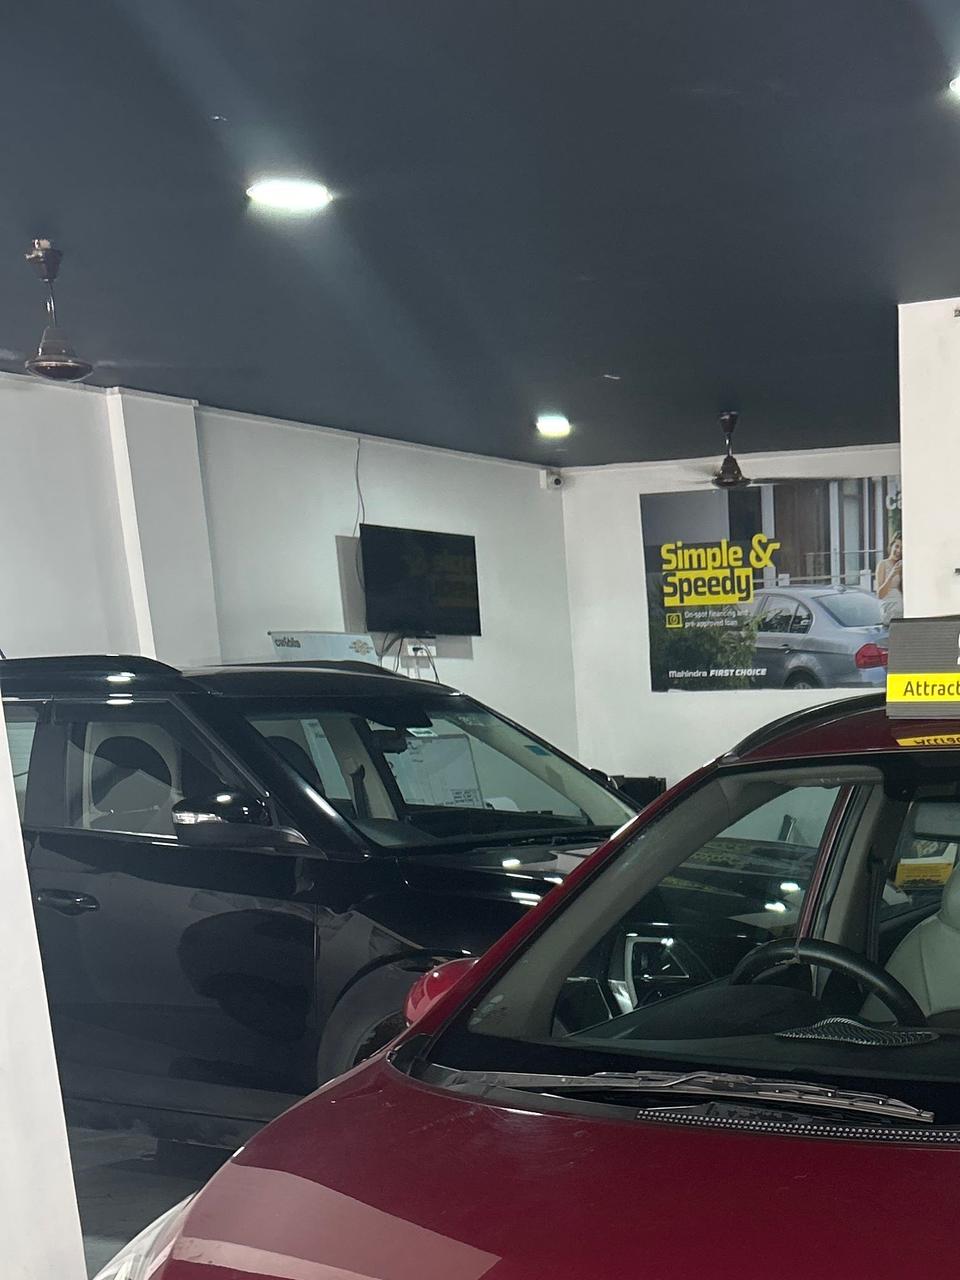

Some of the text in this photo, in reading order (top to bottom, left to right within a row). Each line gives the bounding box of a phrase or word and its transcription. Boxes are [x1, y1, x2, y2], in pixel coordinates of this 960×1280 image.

[660, 533, 780, 571] Simple &
[662, 568, 752, 604] Speedy
[668, 667, 768, 678] Mahindra FIRST CHOICE
